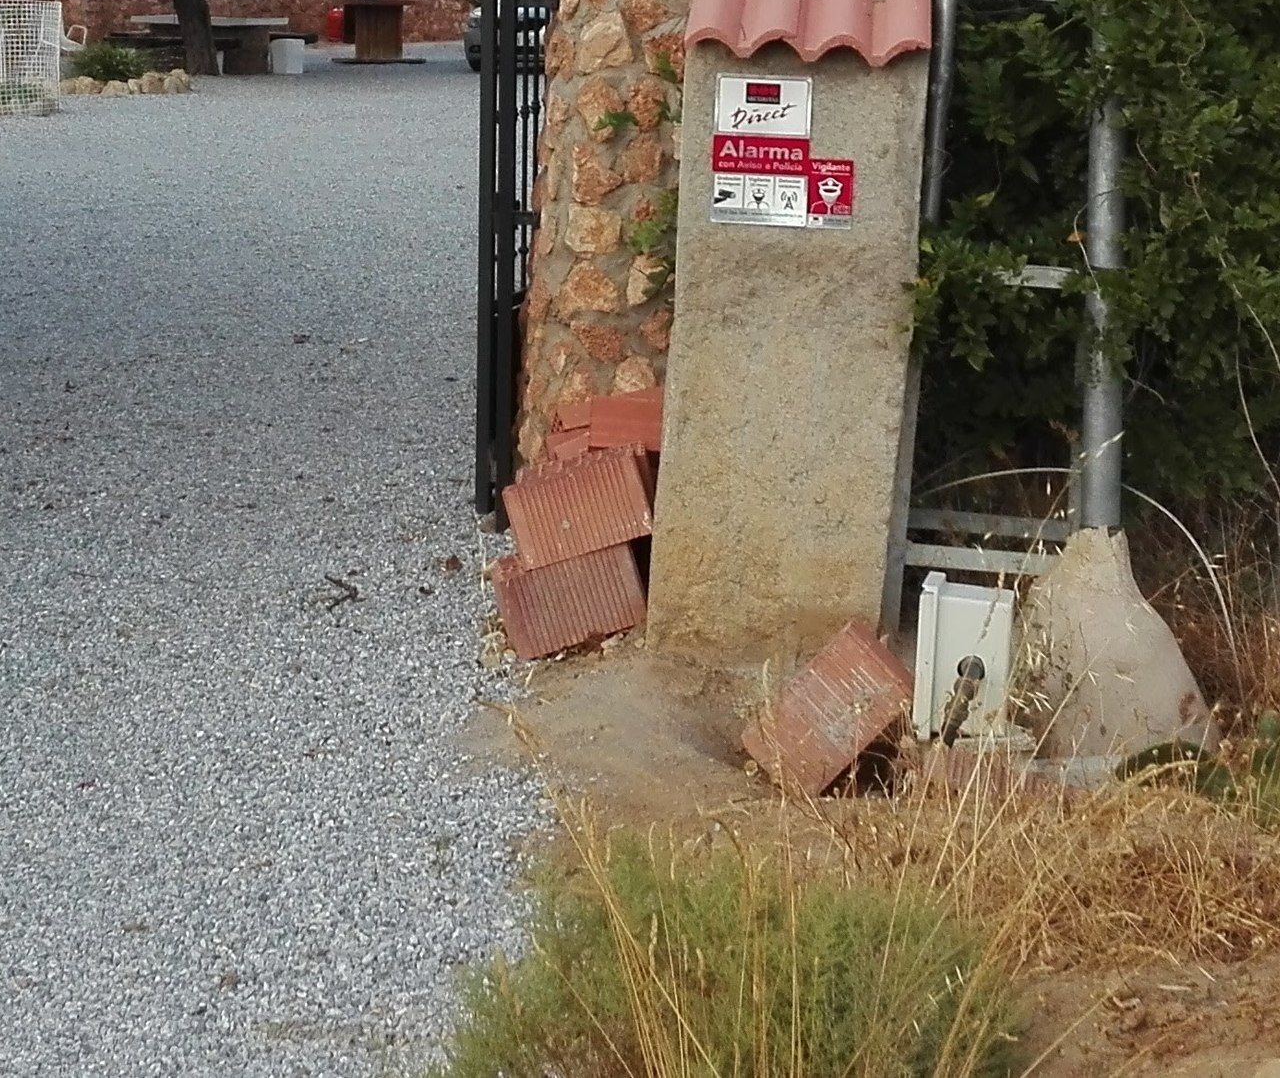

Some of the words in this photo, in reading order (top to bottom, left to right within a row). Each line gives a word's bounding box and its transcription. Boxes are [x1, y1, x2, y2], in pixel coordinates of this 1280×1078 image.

[731, 103, 797, 129] Direct
[719, 139, 803, 161] Alarma
[737, 161, 762, 169] Aviso
[811, 162, 851, 172] Vigilante
